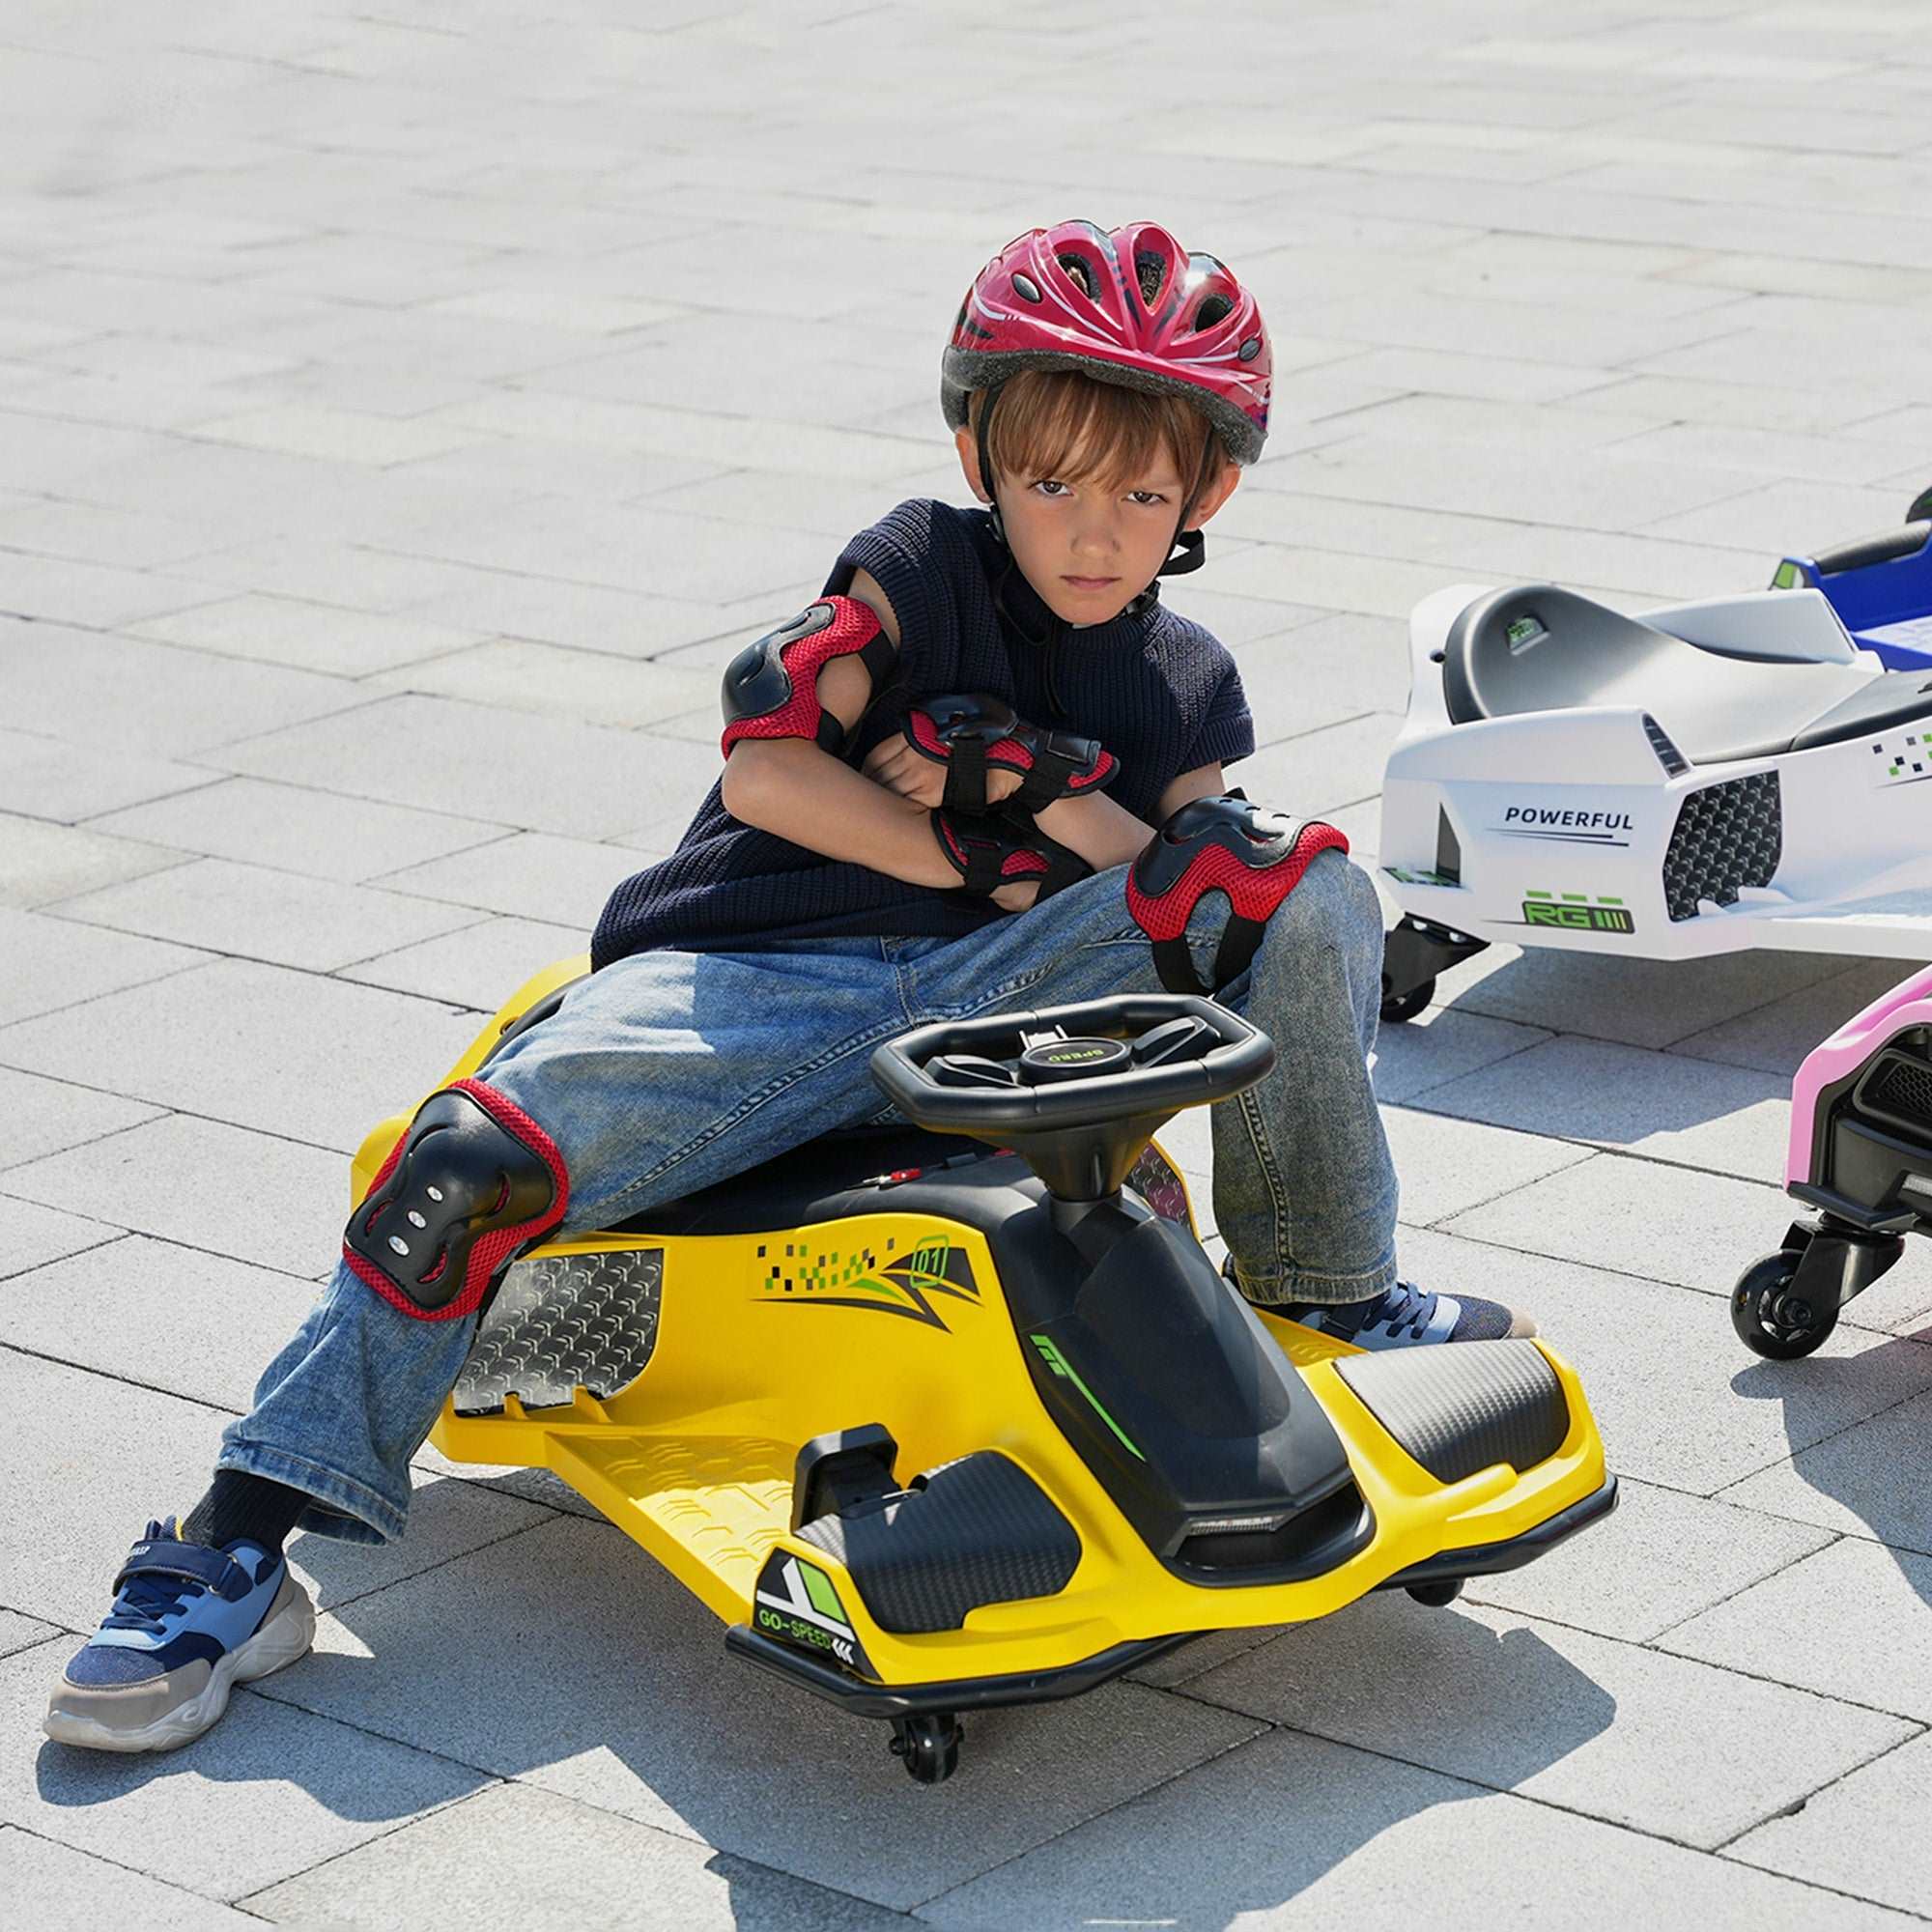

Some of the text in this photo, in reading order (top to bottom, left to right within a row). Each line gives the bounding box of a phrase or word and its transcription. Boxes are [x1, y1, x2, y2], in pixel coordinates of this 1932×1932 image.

[1505, 807, 1634, 831] POWERFUL
[918, 1247, 941, 1274] 01
[758, 1608, 832, 1651] GO-SPEED
